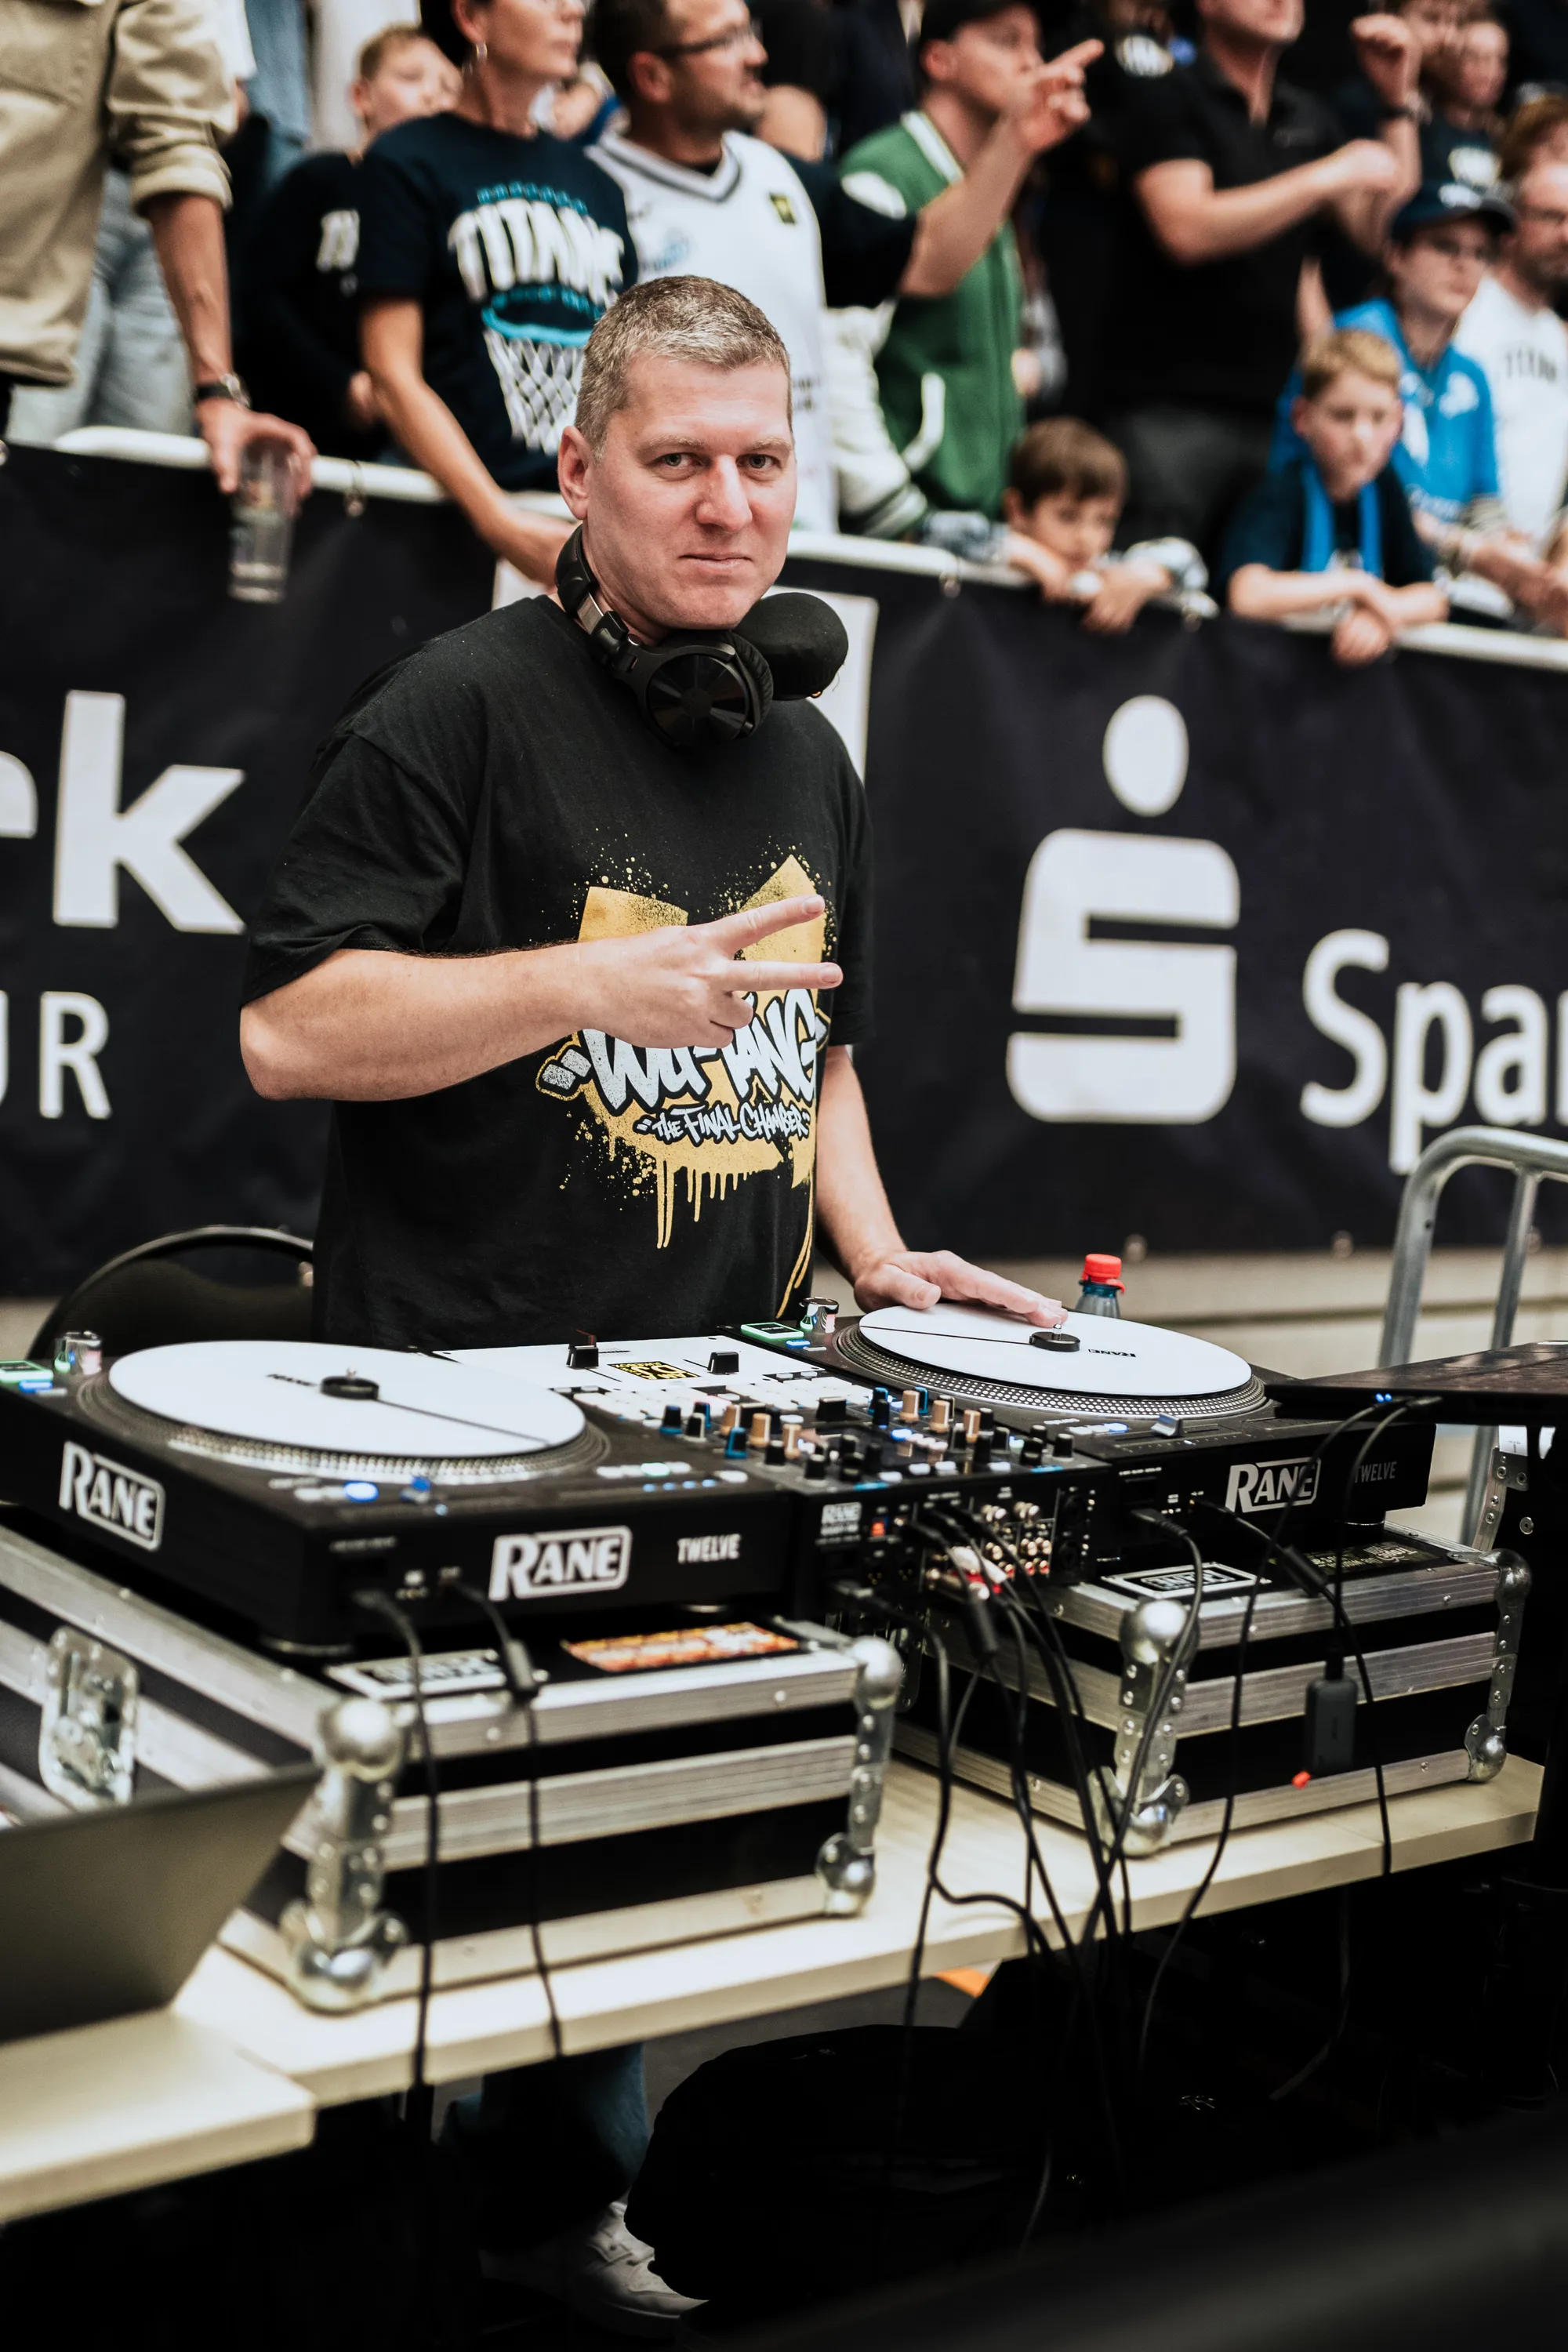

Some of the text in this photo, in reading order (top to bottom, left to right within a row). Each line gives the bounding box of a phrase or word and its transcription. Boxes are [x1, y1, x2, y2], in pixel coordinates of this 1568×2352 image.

[59, 1441, 163, 1546] RANE
[1225, 1458, 1319, 1513] RANE
[488, 1527, 740, 1601] RANE TWELVE
